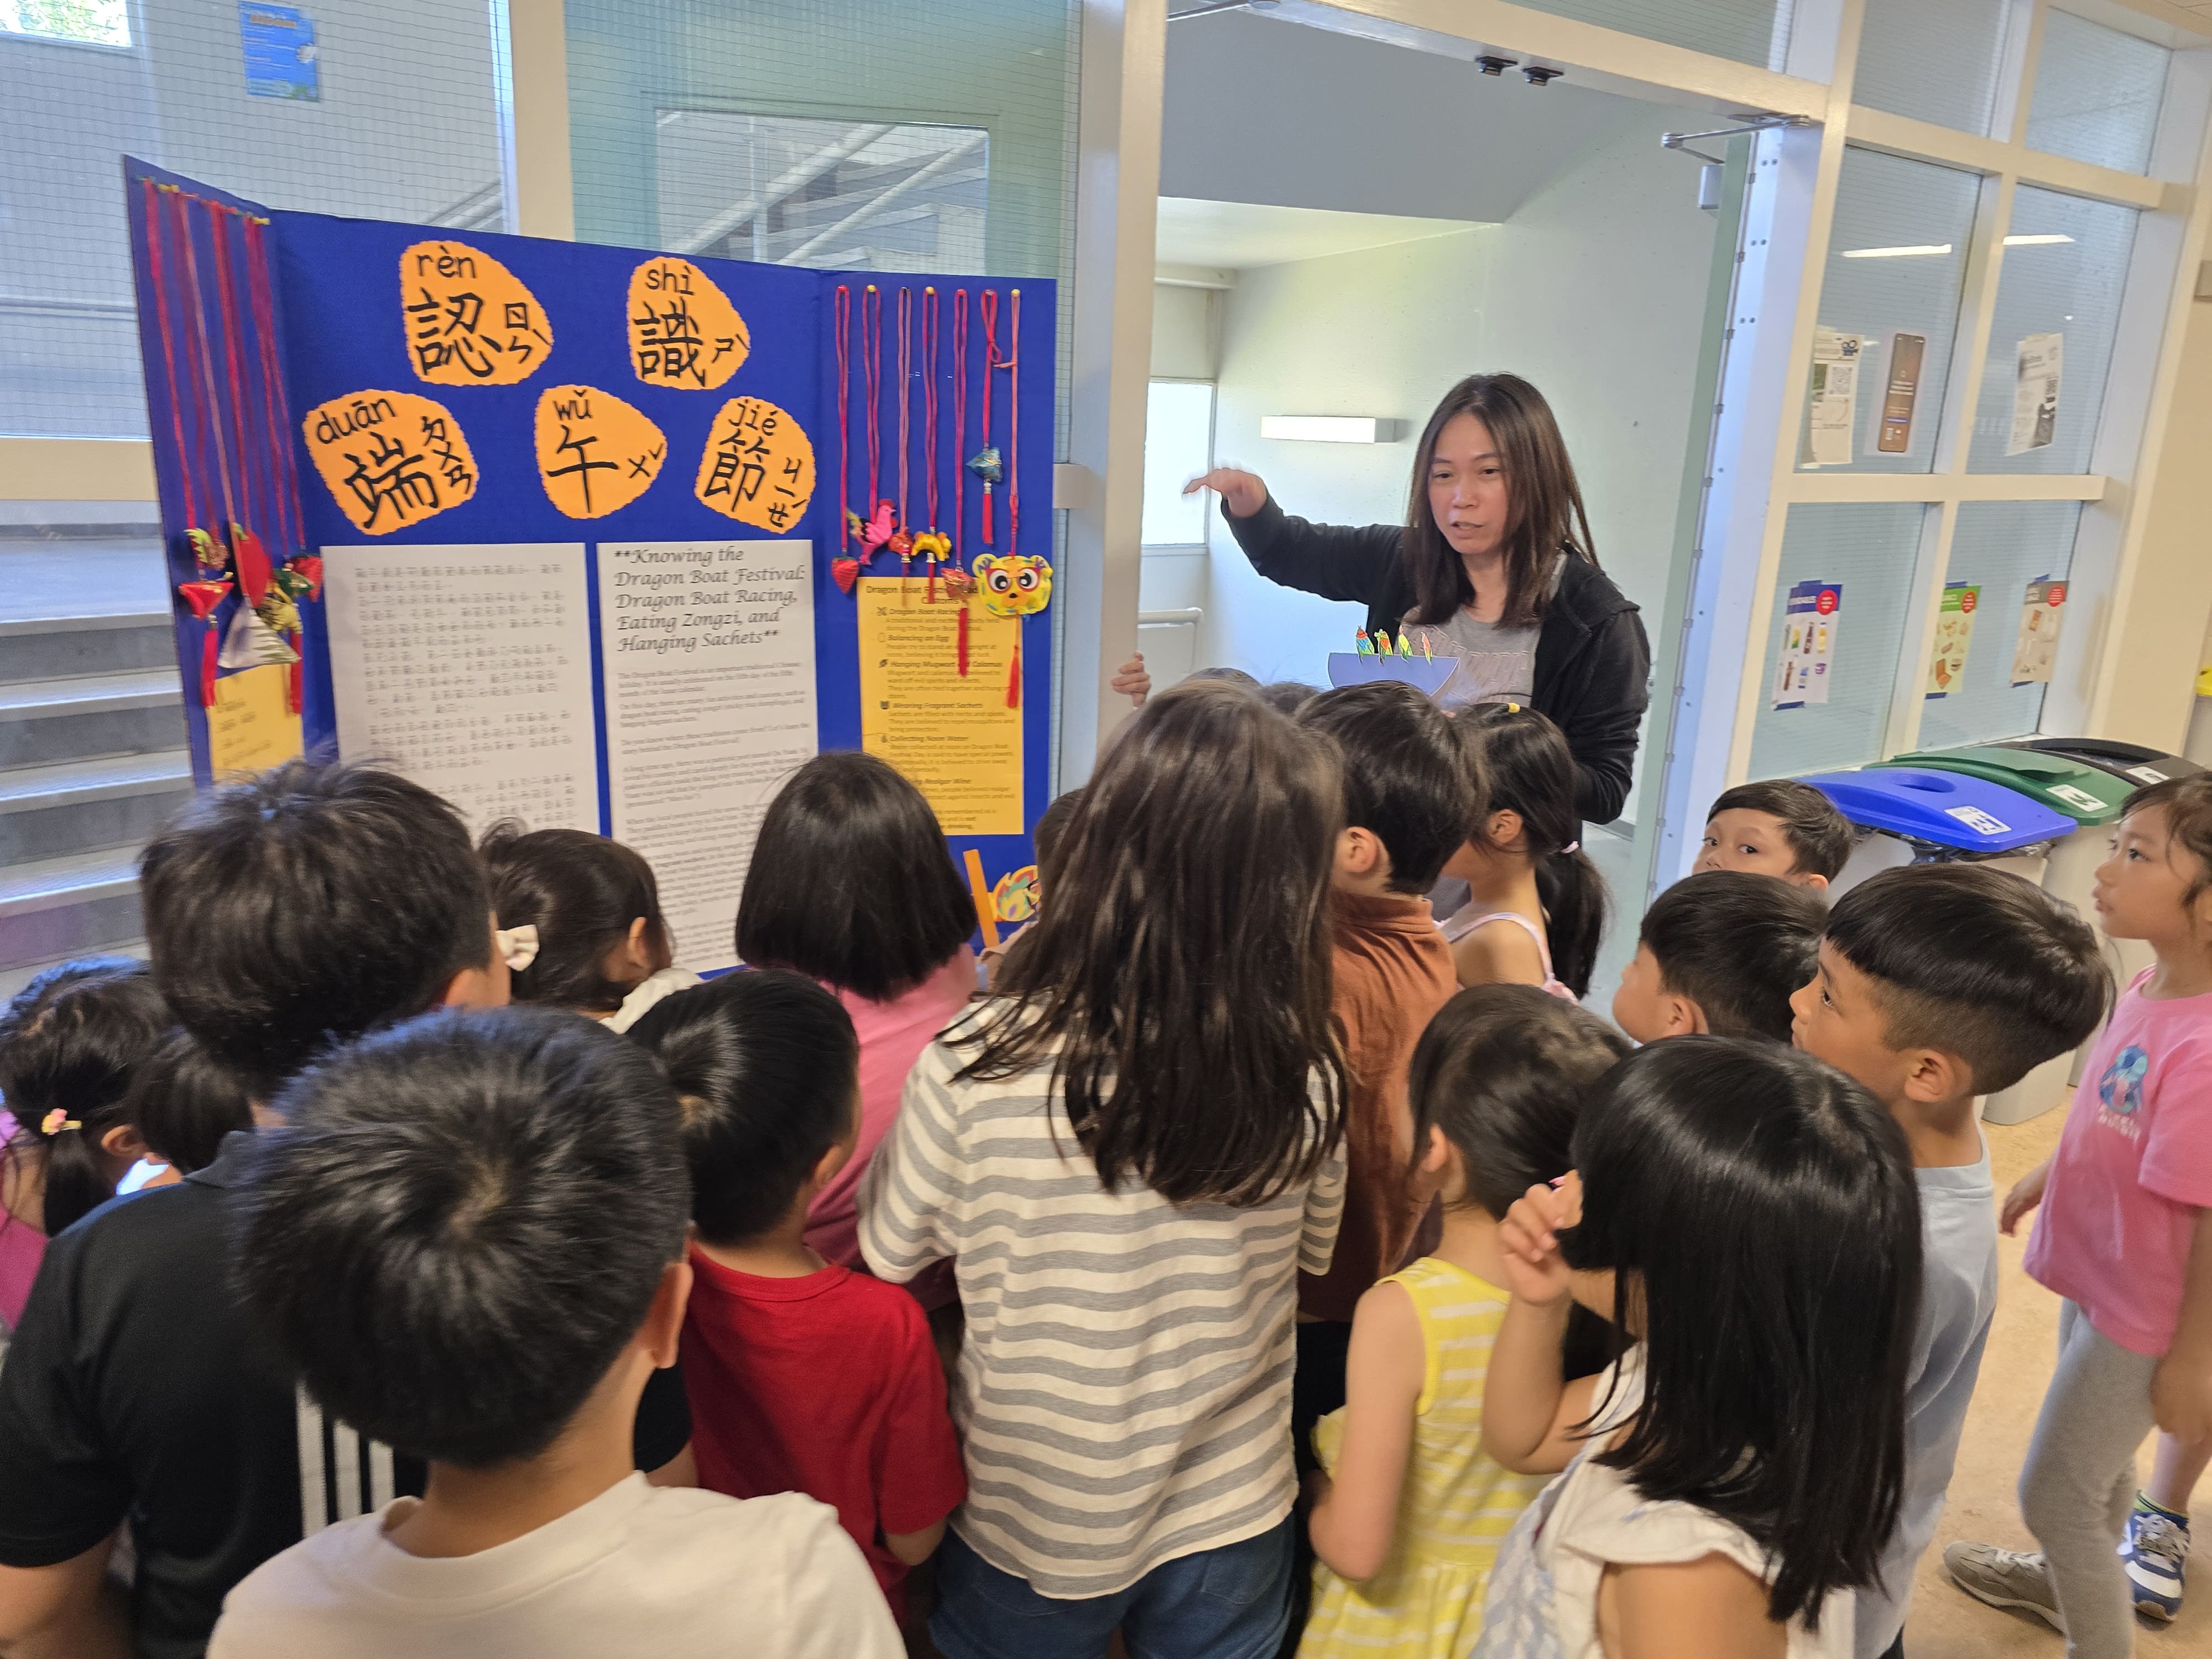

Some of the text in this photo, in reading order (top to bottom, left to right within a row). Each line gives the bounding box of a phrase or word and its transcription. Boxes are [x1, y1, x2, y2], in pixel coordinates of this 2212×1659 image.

[418, 246, 476, 278] rèn
[646, 257, 694, 296] shì
[408, 288, 502, 378] 認
[634, 299, 706, 387] 識
[316, 398, 395, 445] duān
[554, 390, 592, 420] wǔ
[728, 403, 778, 437] jié
[345, 431, 440, 529] 端
[547, 425, 618, 513] 午
[707, 429, 770, 512] 節
[718, 545, 744, 561] the
[614, 566, 805, 589] Dragon Boat Festival:
[867, 586, 899, 594] Dragon
[615, 589, 798, 612] Dragon Boat Racing,
[617, 607, 783, 633] Eating Zongzi, and
[617, 634, 697, 654] Hanging
